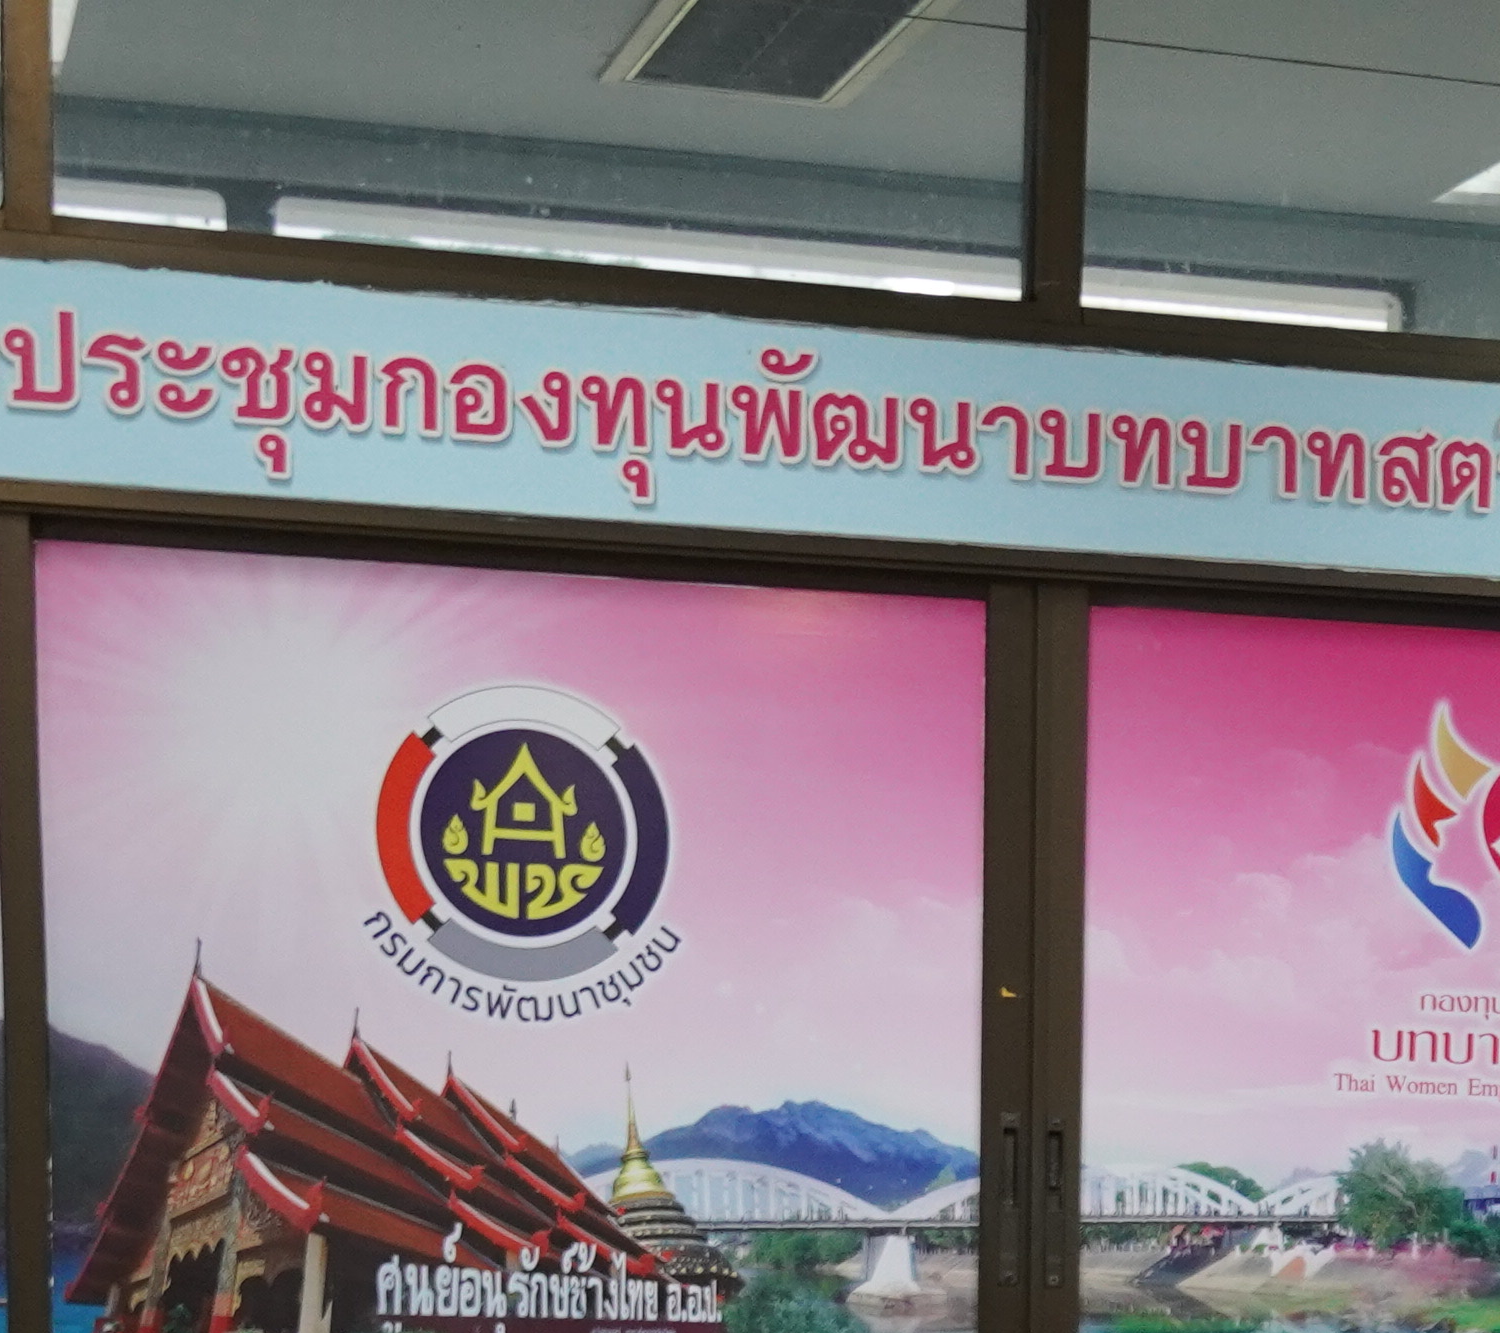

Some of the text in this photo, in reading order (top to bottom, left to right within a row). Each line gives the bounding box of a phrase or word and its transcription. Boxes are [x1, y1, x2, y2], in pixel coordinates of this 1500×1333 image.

[362, 909, 684, 1024] กรมการพัฒนาชุมชน
[1334, 1073, 1376, 1093] Thai
[1386, 1074, 1458, 1096] Women
